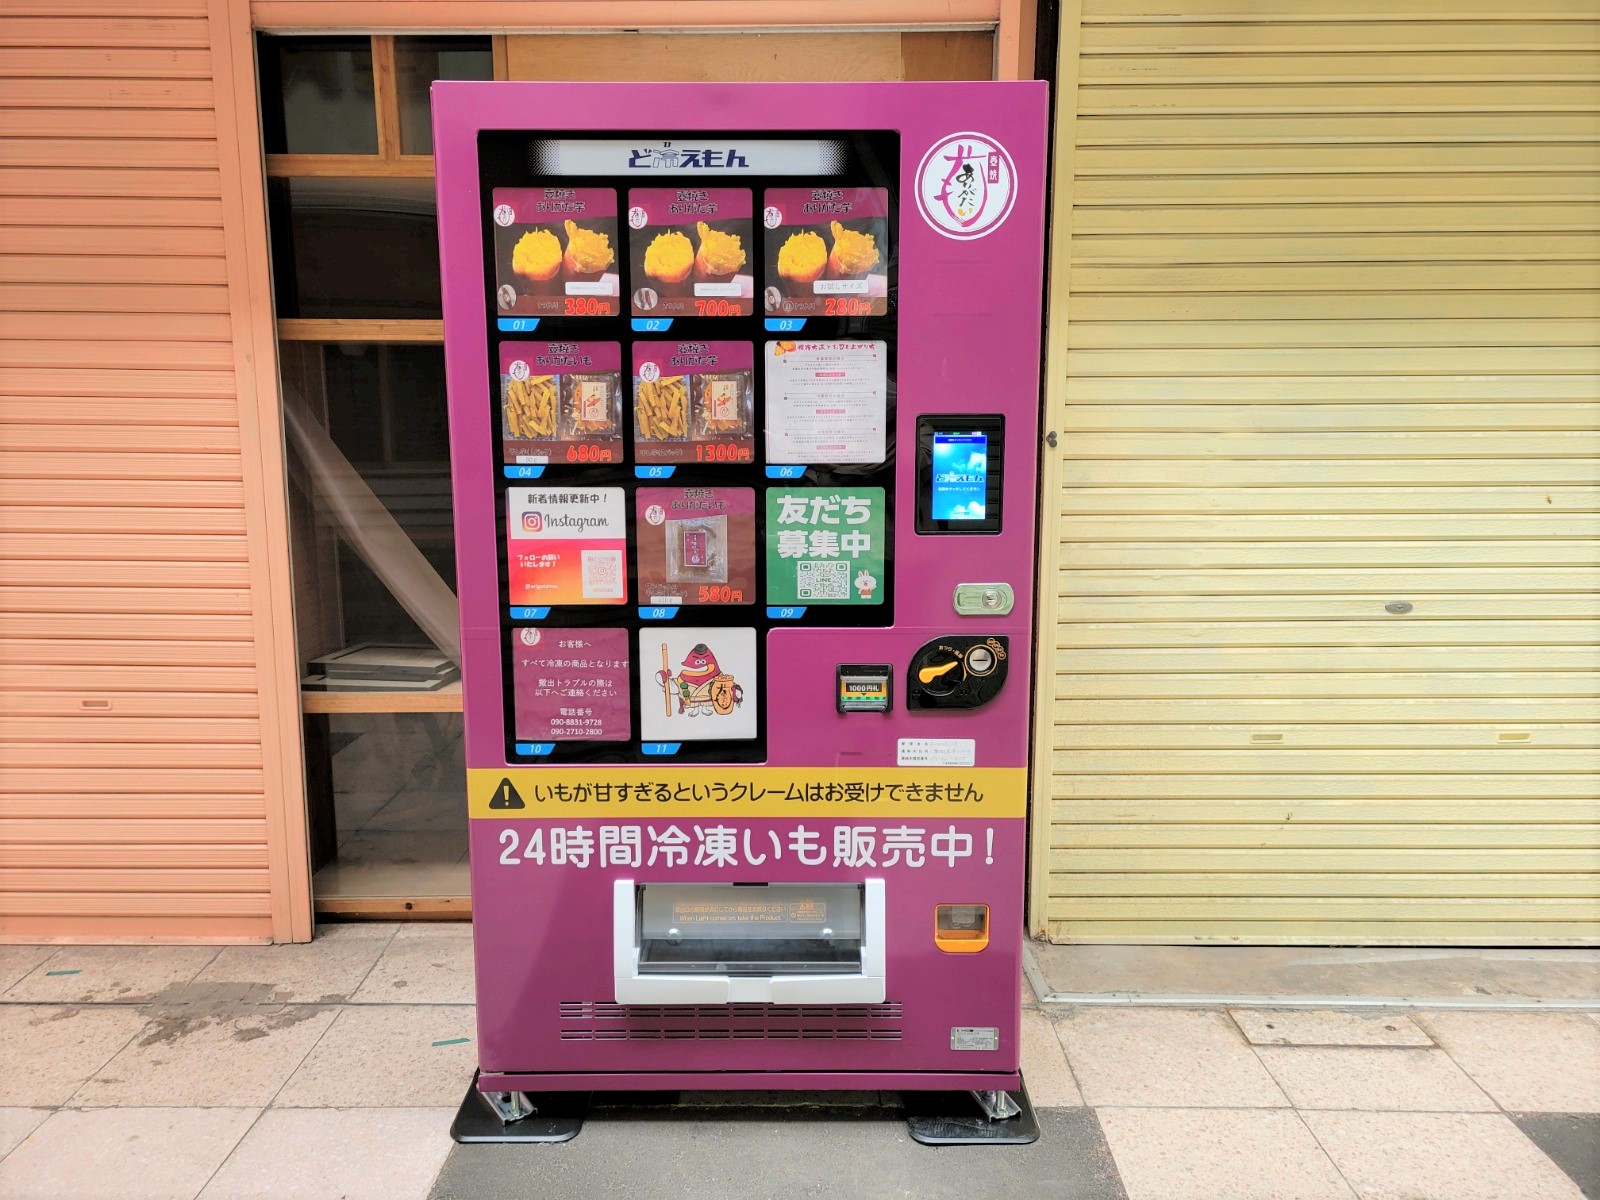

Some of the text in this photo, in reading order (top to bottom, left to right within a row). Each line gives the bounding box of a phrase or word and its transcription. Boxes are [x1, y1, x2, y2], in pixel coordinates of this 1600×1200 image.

[819, 282, 863, 291] お試しサイズ
[564, 297, 611, 315] 380円
[695, 299, 742, 316] 700円
[825, 298, 871, 315] 280円
[513, 321, 525, 330] 01
[646, 321, 659, 330] 02
[780, 321, 793, 330] 03
[566, 444, 612, 462] 680円
[696, 444, 750, 462] 1300円
[519, 468, 532, 477] 04
[649, 468, 662, 477] 05
[780, 467, 793, 477] 06
[777, 494, 872, 525] 友だち
[544, 513, 609, 533] Instagram
[777, 529, 871, 558] 募集中
[698, 585, 743, 602] 580円
[524, 608, 537, 617] 07
[652, 608, 665, 617] 08
[780, 608, 794, 617] 09
[558, 640, 592, 649] お客様へ
[521, 660, 629, 668] すべて冷凍の商品となります
[535, 688, 617, 697] 以下へご連絡ください
[849, 684, 879, 692] 1000円札
[559, 707, 593, 716] 電話番号
[530, 744, 542, 753] 10
[656, 744, 667, 753] 11
[534, 781, 984, 803] いもが甘すぎるというクレームはお受けできません
[696, 915, 709, 923] Light
